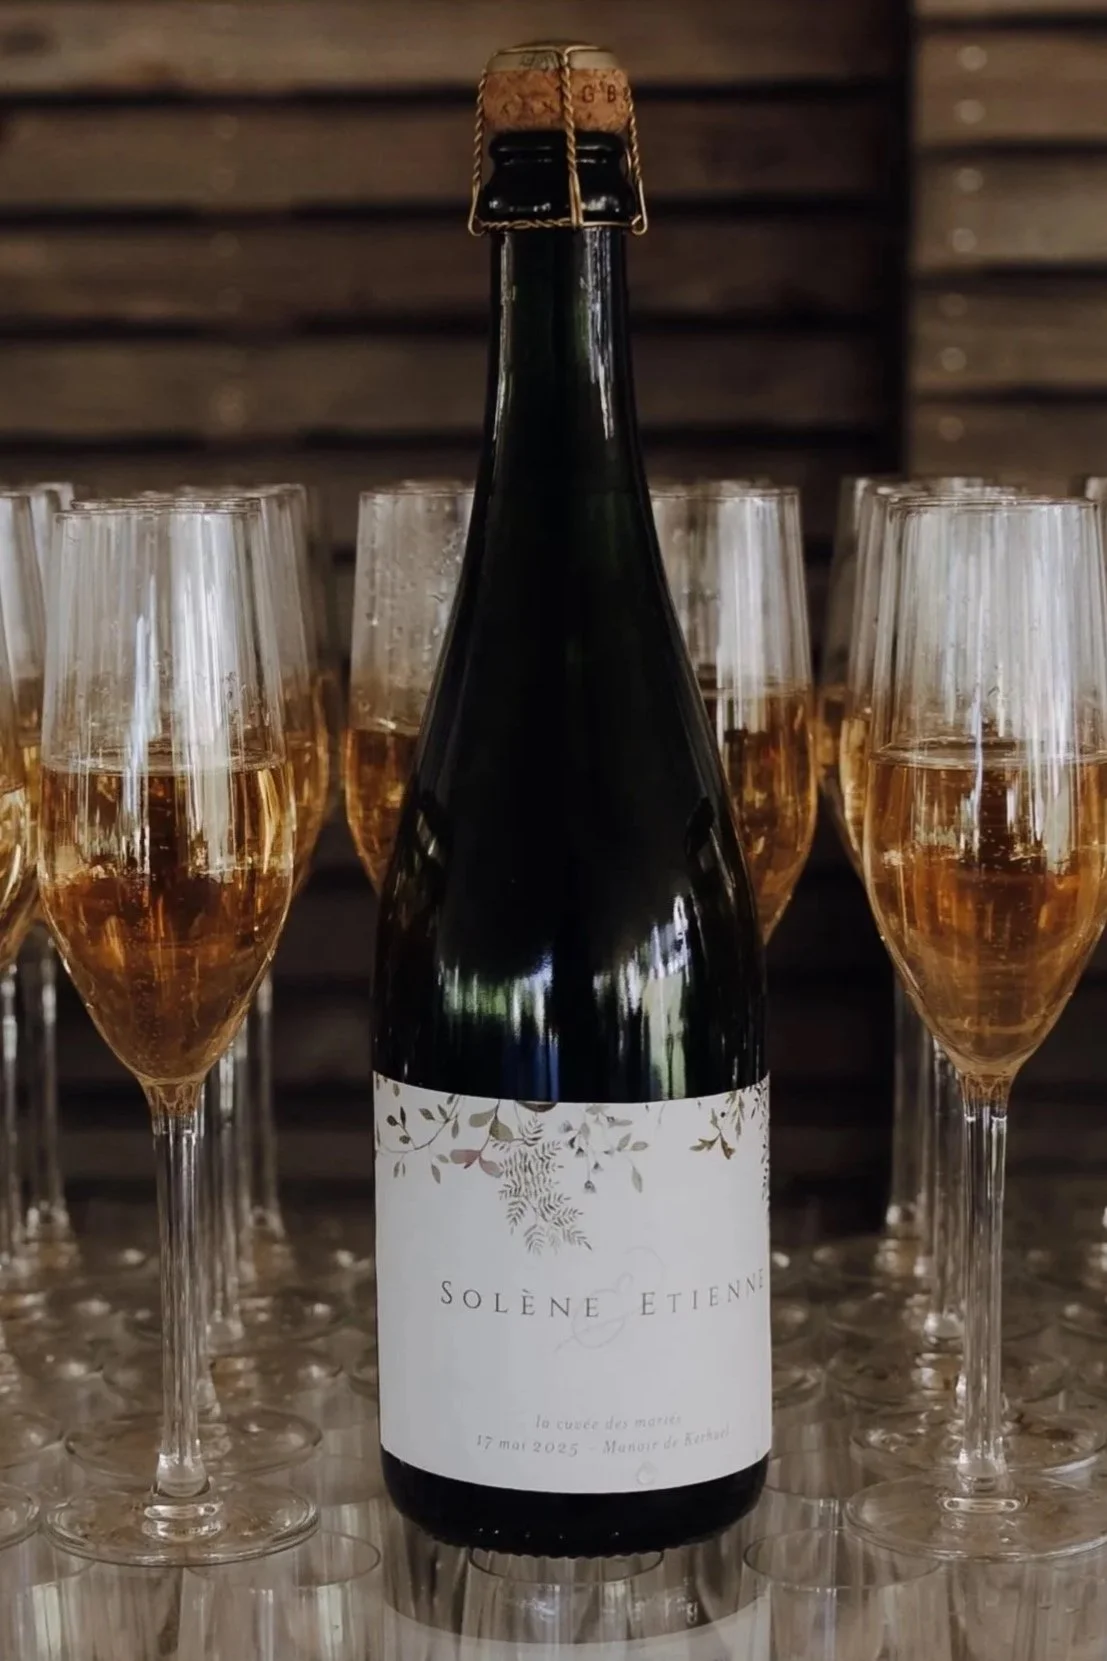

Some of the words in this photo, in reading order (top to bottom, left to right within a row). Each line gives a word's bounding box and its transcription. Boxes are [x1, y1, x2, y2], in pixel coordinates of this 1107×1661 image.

[440, 1280, 600, 1318] SOLÈNE
[641, 1268, 764, 1316] ETIENNE
[536, 1413, 550, 1430] la
[556, 1416, 599, 1430] cuvée
[605, 1415, 628, 1430] des
[634, 1410, 682, 1428] mariés
[476, 1434, 493, 1450] 17
[499, 1439, 525, 1450] mai
[532, 1441, 579, 1458] 2025
[602, 1440, 658, 1455] Manoir
[664, 1435, 678, 1450] de
